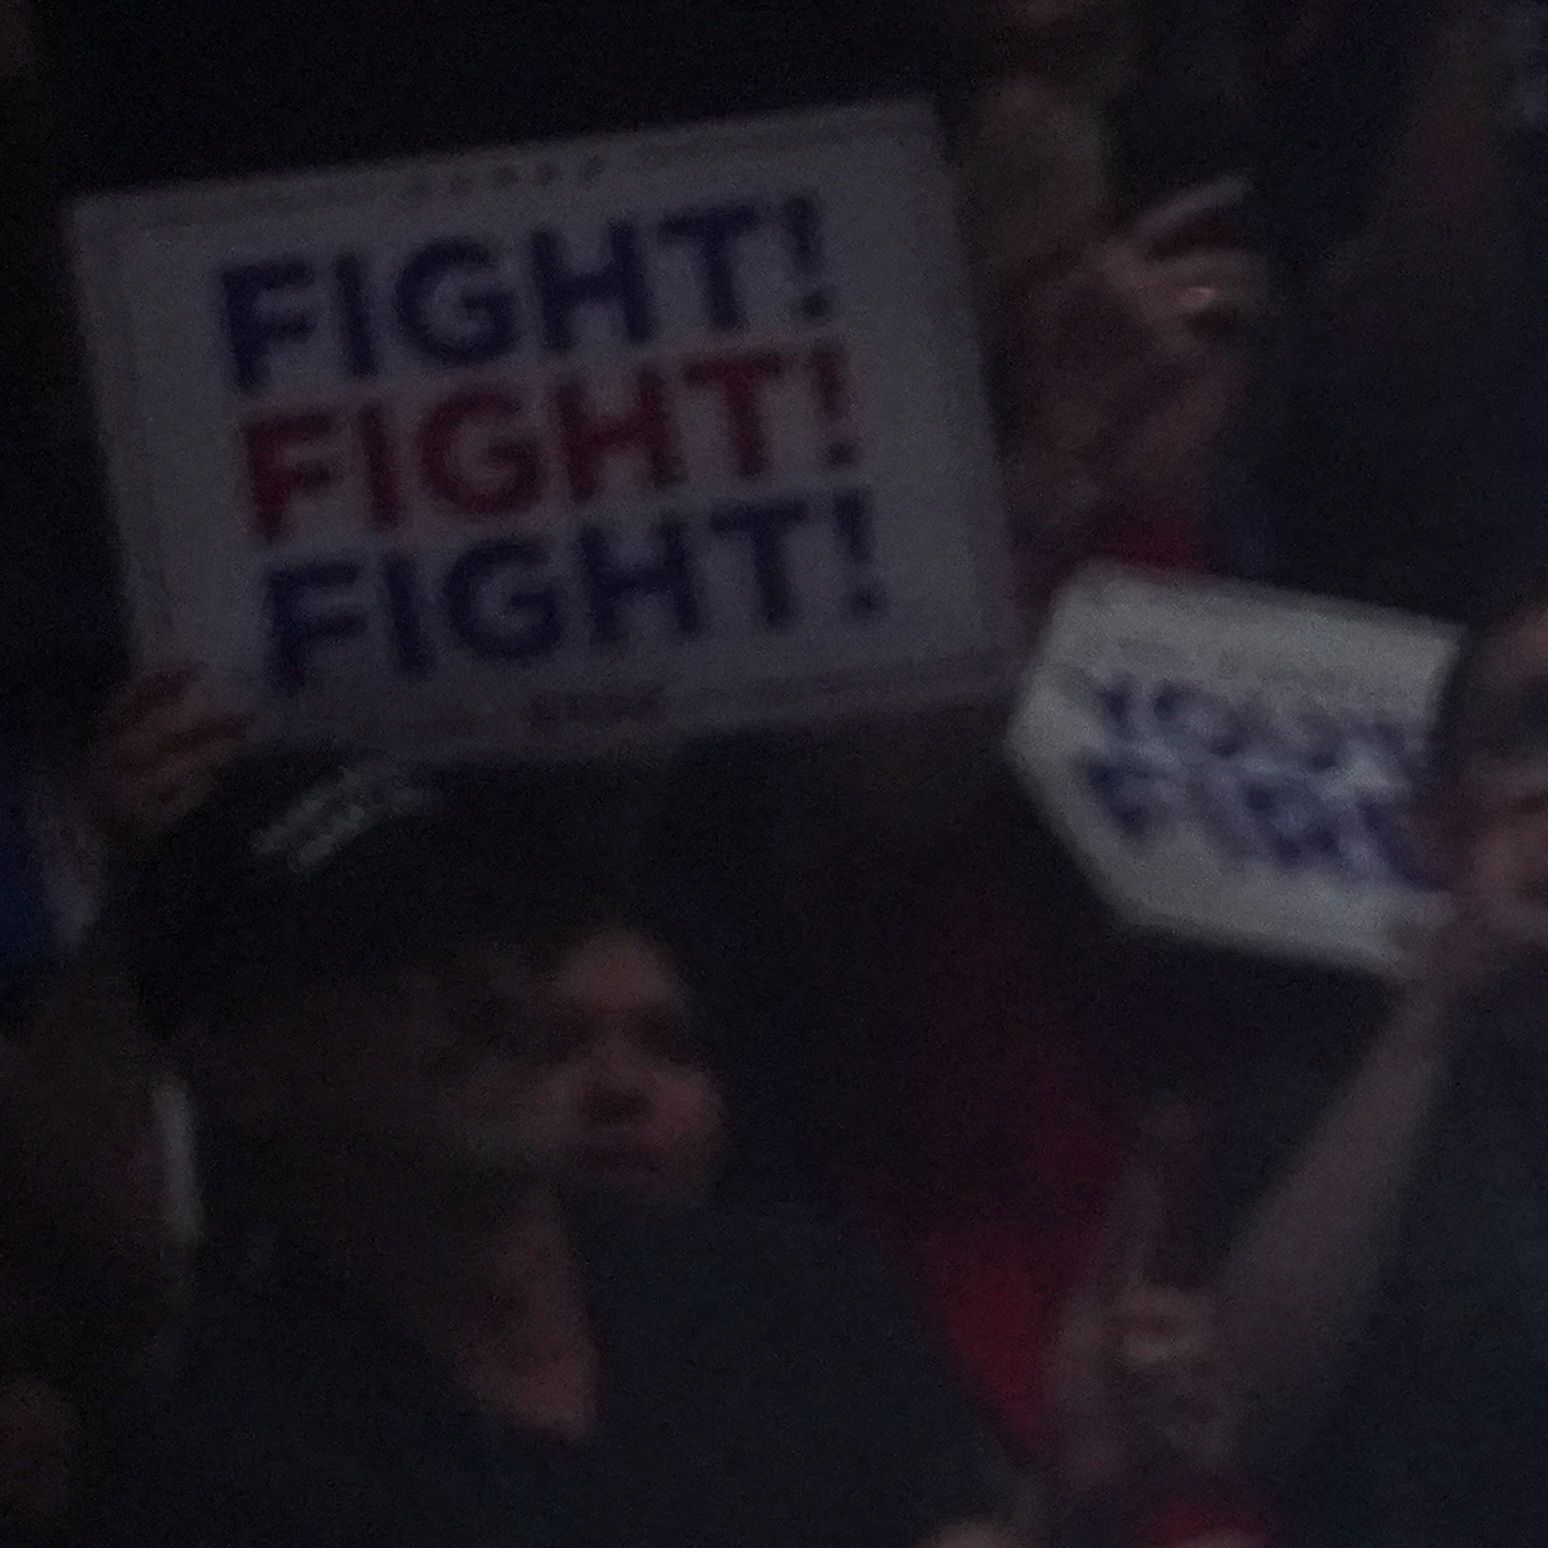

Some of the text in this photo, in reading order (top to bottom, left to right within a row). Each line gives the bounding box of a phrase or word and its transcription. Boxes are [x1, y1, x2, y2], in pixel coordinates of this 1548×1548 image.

[217, 197, 834, 394] FIGHT!
[241, 342, 861, 541] FIGHT!
[261, 489, 884, 693] FIGHT!
